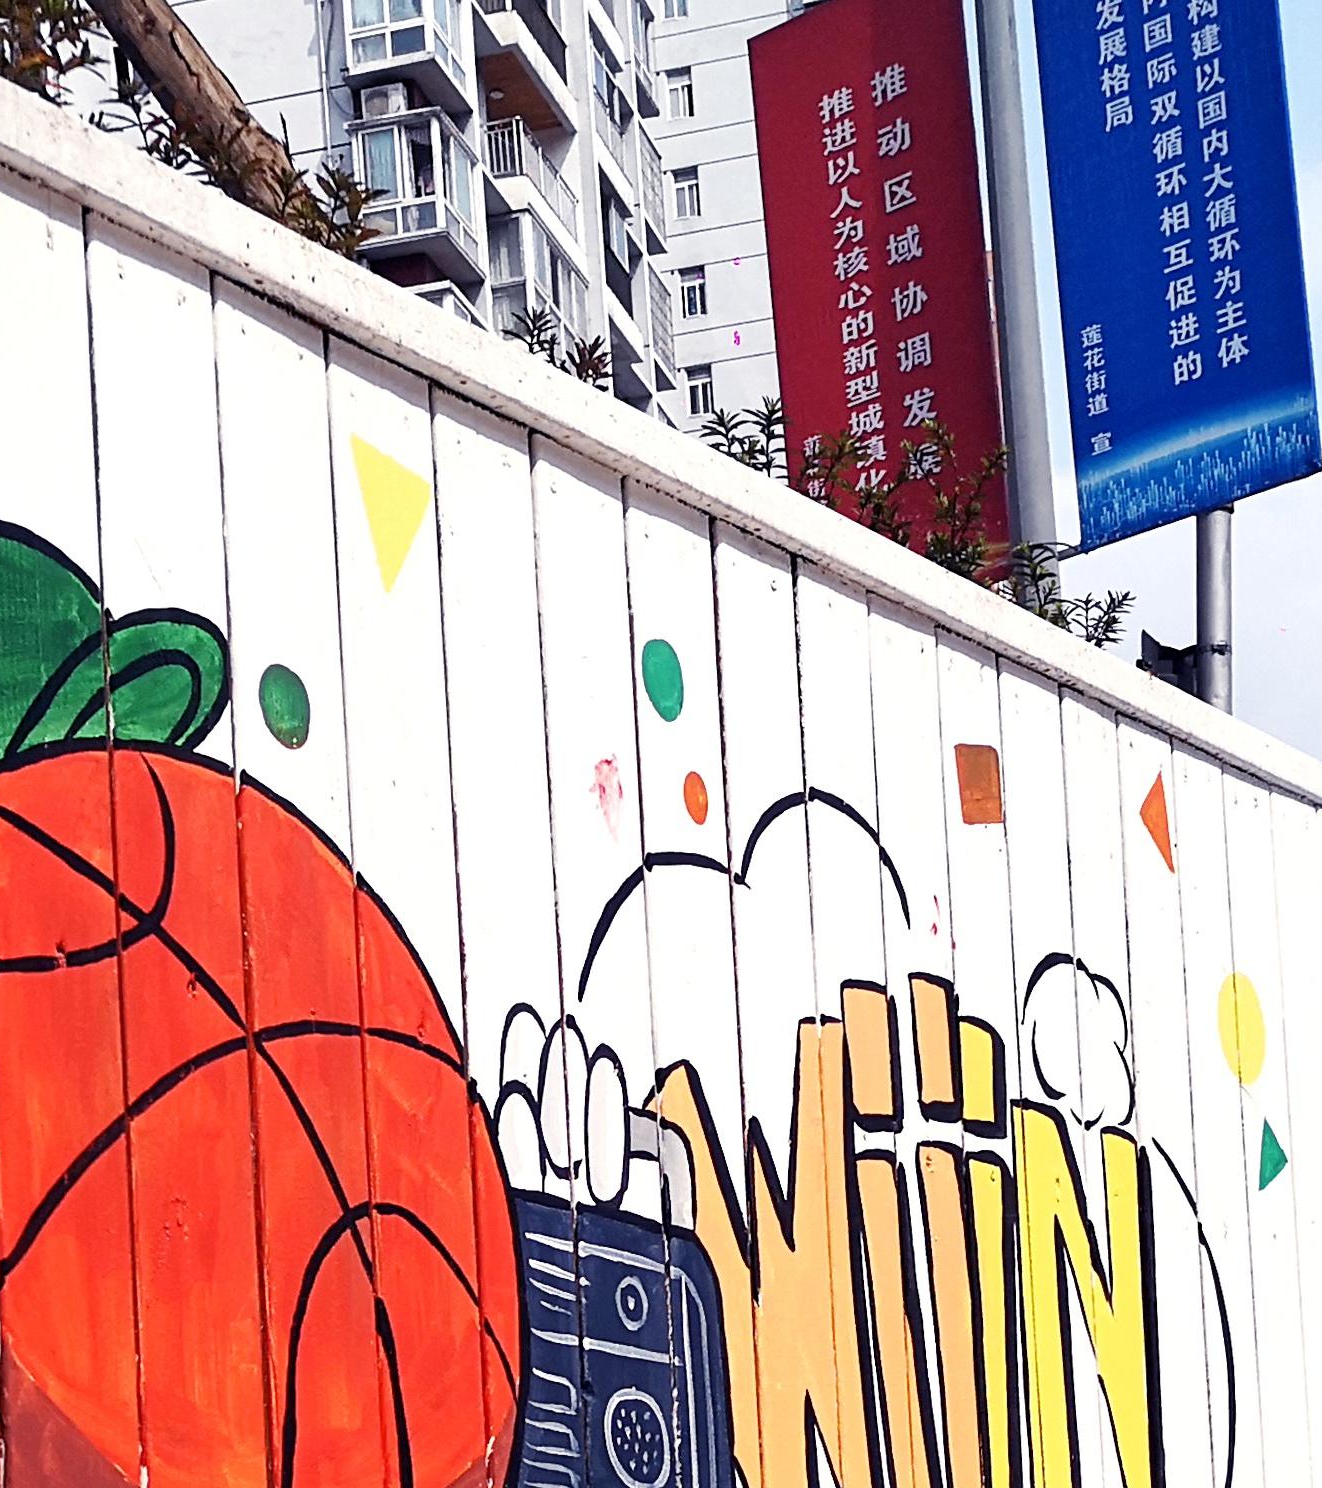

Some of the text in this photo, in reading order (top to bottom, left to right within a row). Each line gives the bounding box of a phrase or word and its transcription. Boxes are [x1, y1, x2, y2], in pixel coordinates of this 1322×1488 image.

[1095, 0, 1134, 133] 发展格局
[1187, 0, 1249, 368] 构建以国内大循环为主体
[1080, 323, 1114, 457] 莲花街道 宣
